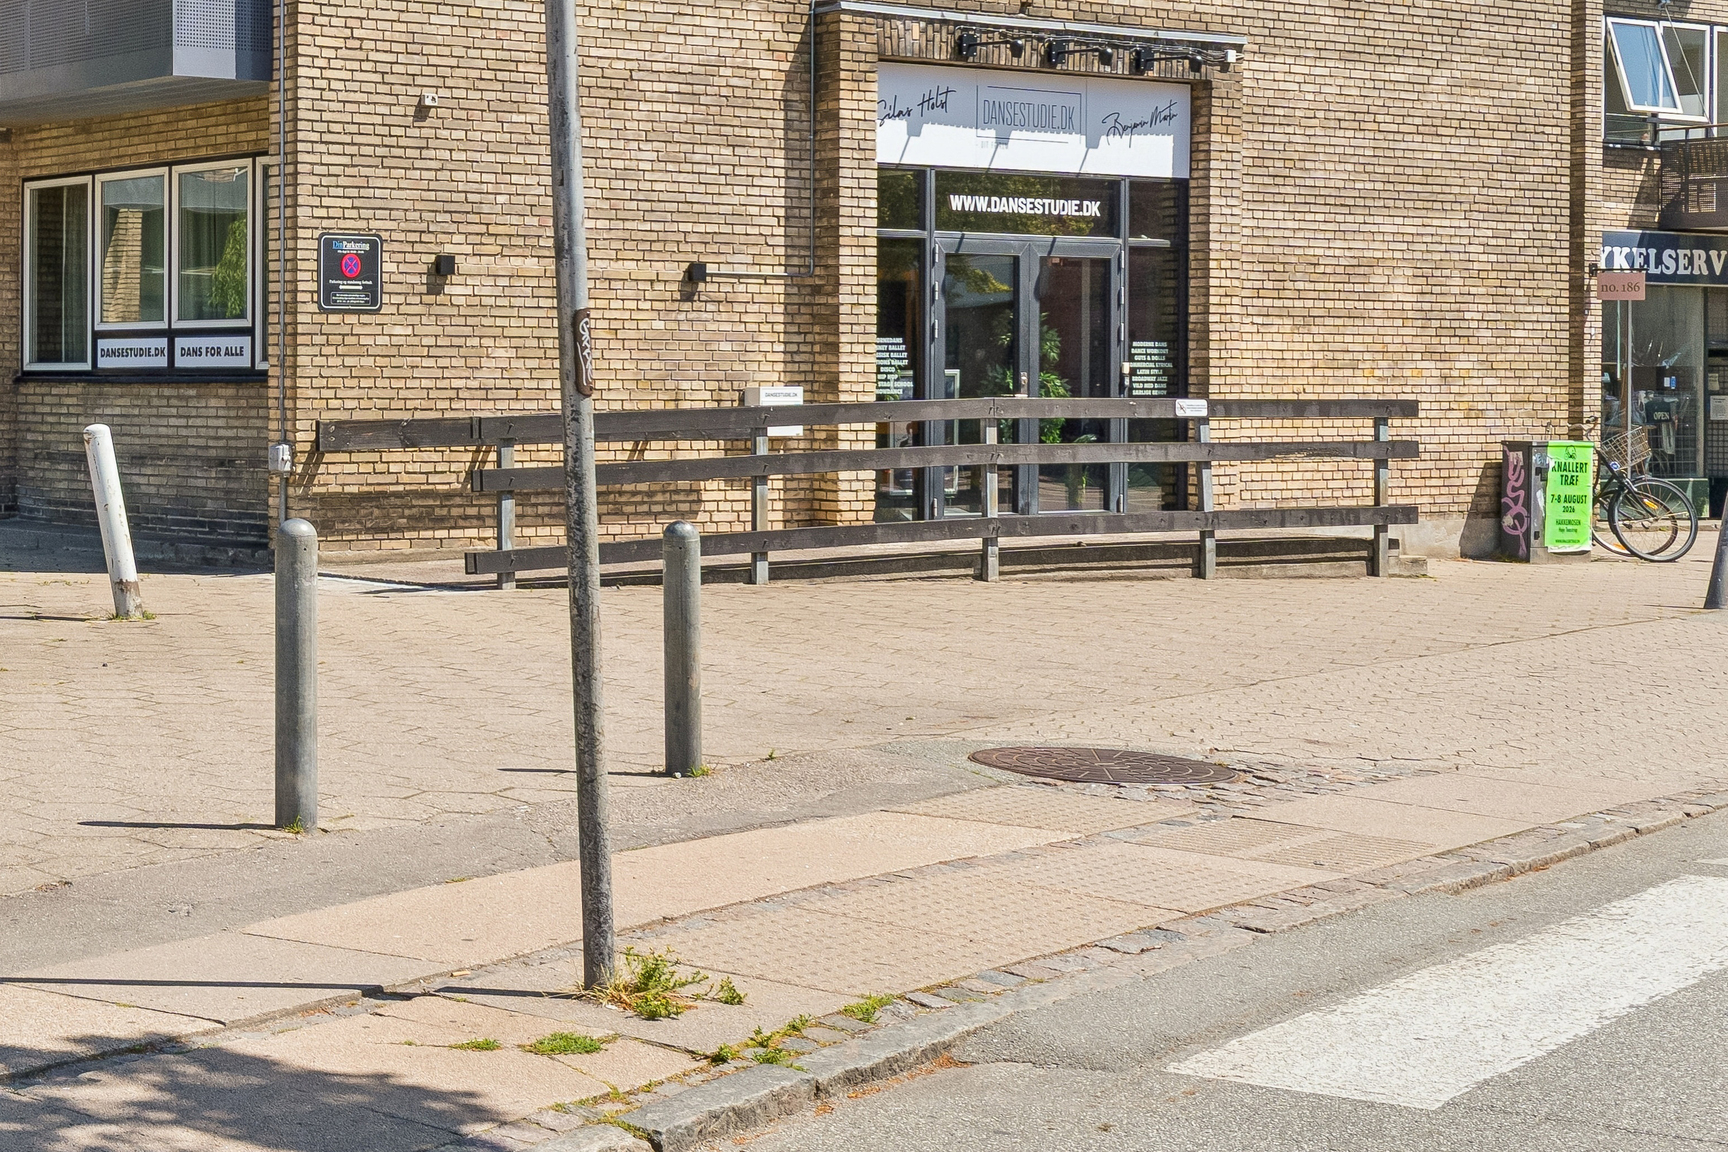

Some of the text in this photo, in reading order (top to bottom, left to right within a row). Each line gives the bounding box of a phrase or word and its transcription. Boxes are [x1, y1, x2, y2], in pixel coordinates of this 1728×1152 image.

[876, 85, 956, 128] Silas Holst
[982, 99, 1075, 131] DANSESTUDIE.DK
[949, 194, 1101, 217] WWW.DANSESTUDIE.DK
[1601, 282, 1640, 292] no. 186
[100, 347, 166, 358] DANSESTUDIE.DK
[180, 346, 244, 357] DANS FOR ALLE
[1653, 412, 1670, 420] OPEN
[1552, 461, 1588, 473] KNALLERT
[1560, 475, 1579, 486] TRÆF
[1551, 494, 1587, 504] 7-8 AUGUST
